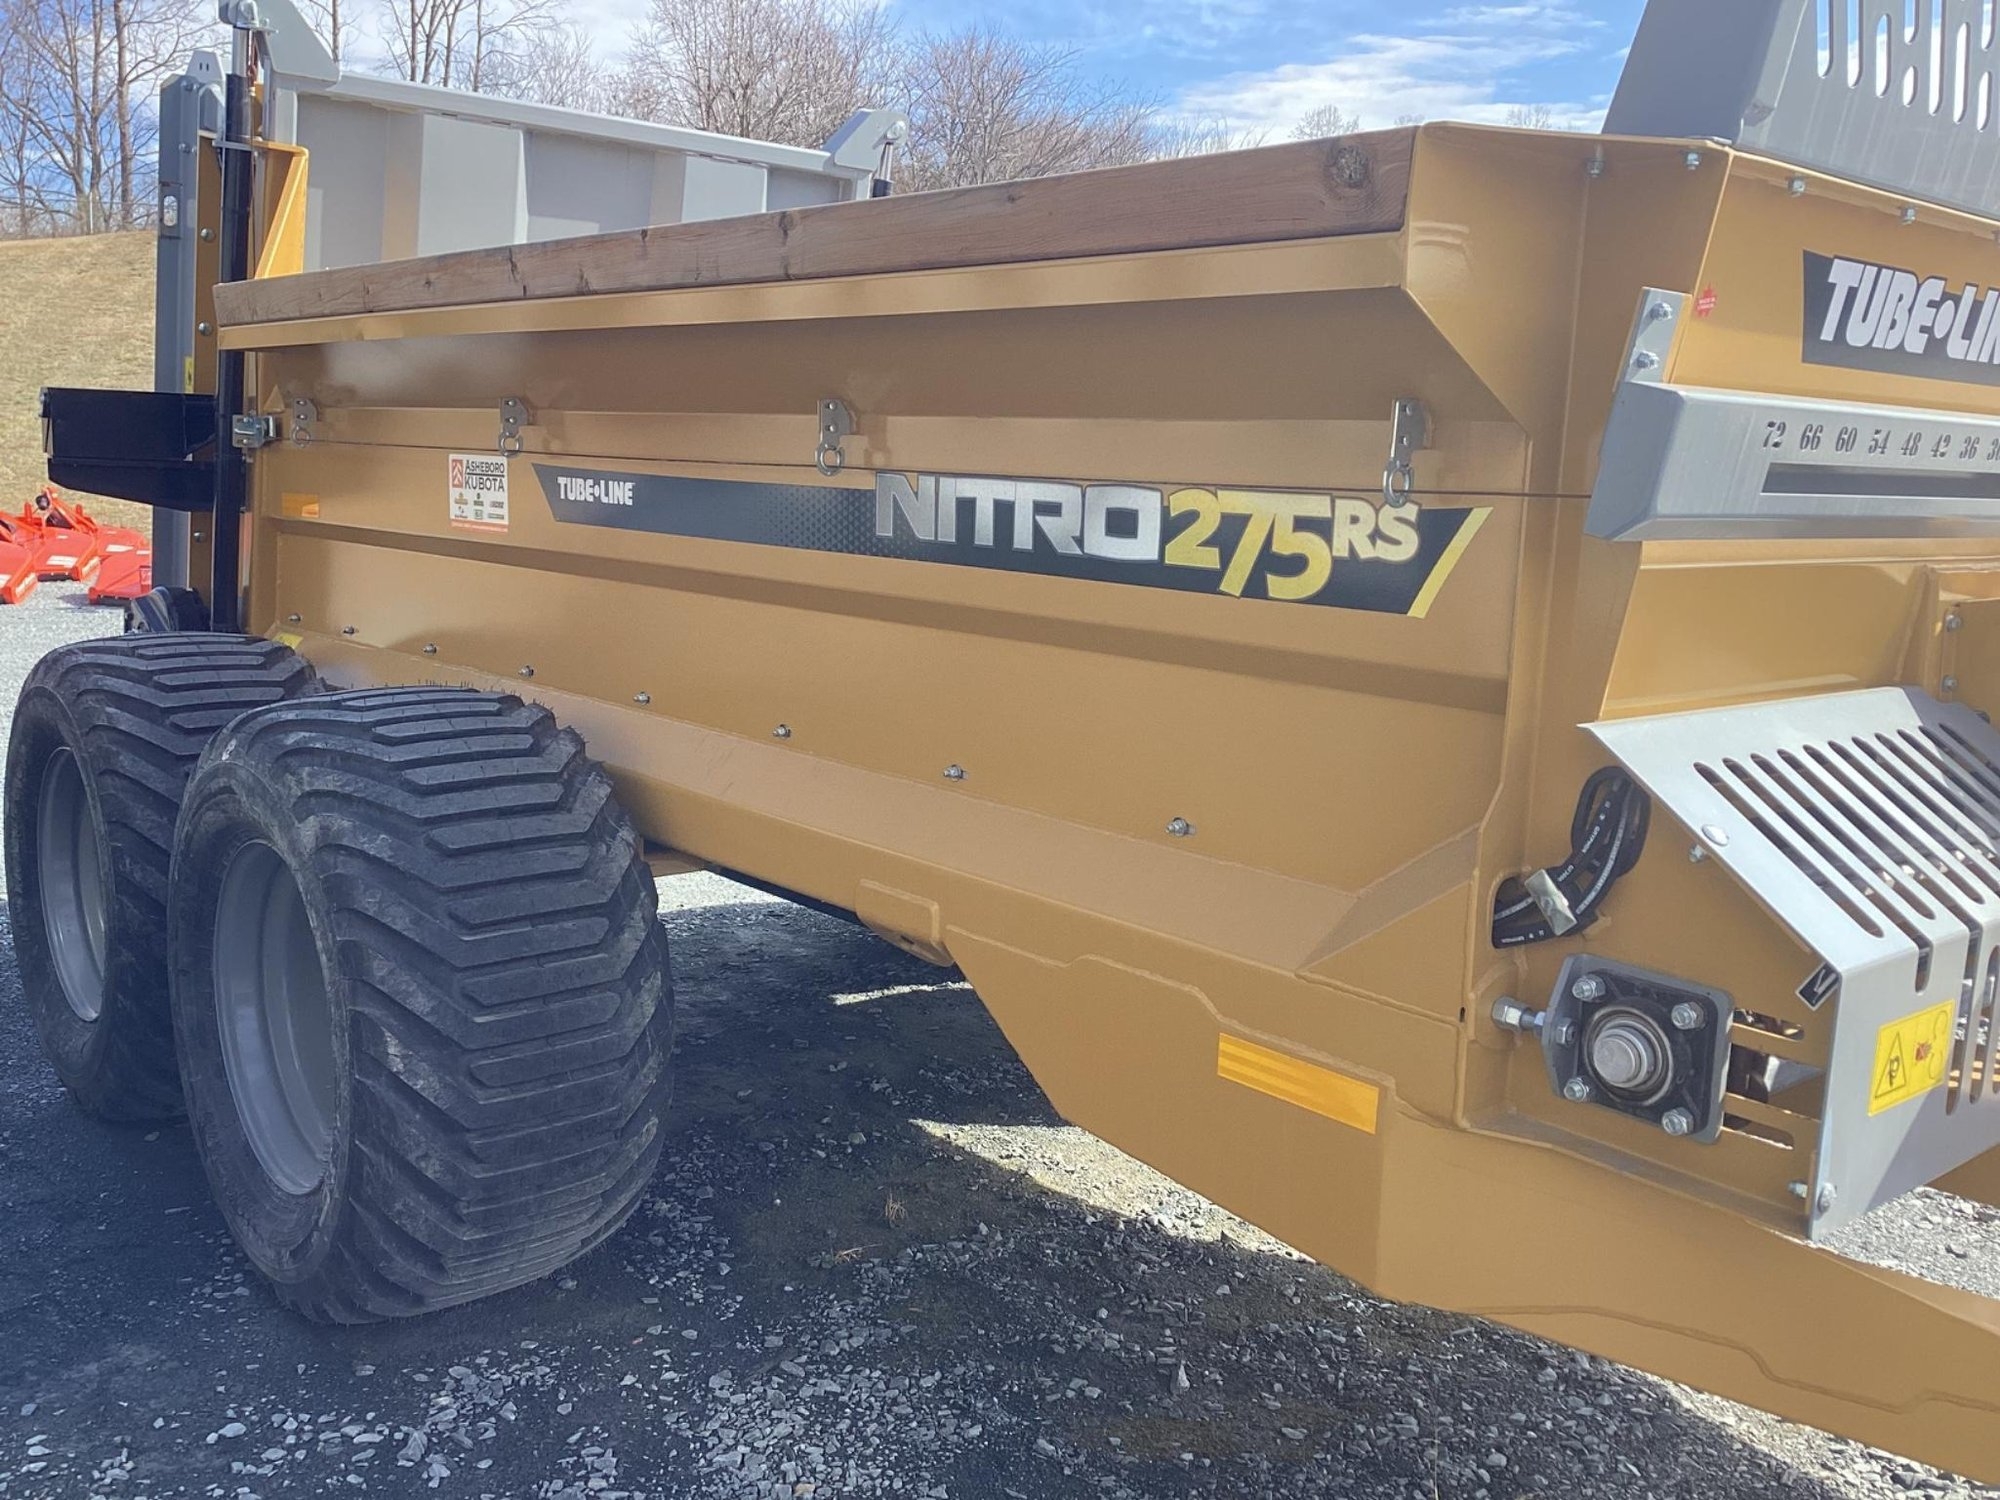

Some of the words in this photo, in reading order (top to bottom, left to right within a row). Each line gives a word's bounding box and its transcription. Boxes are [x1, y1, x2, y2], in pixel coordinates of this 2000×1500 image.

[1763, 421, 1786, 448] 72
[1800, 424, 1823, 451] 66
[1835, 426, 1857, 452] 60
[1868, 429, 1891, 454] 54
[1900, 432, 1922, 457] 48
[1930, 434, 1951, 458] 42
[1959, 436, 1980, 459] 36
[465, 459, 505, 474] ASHEBORO
[465, 476, 505, 492] KUBOTA
